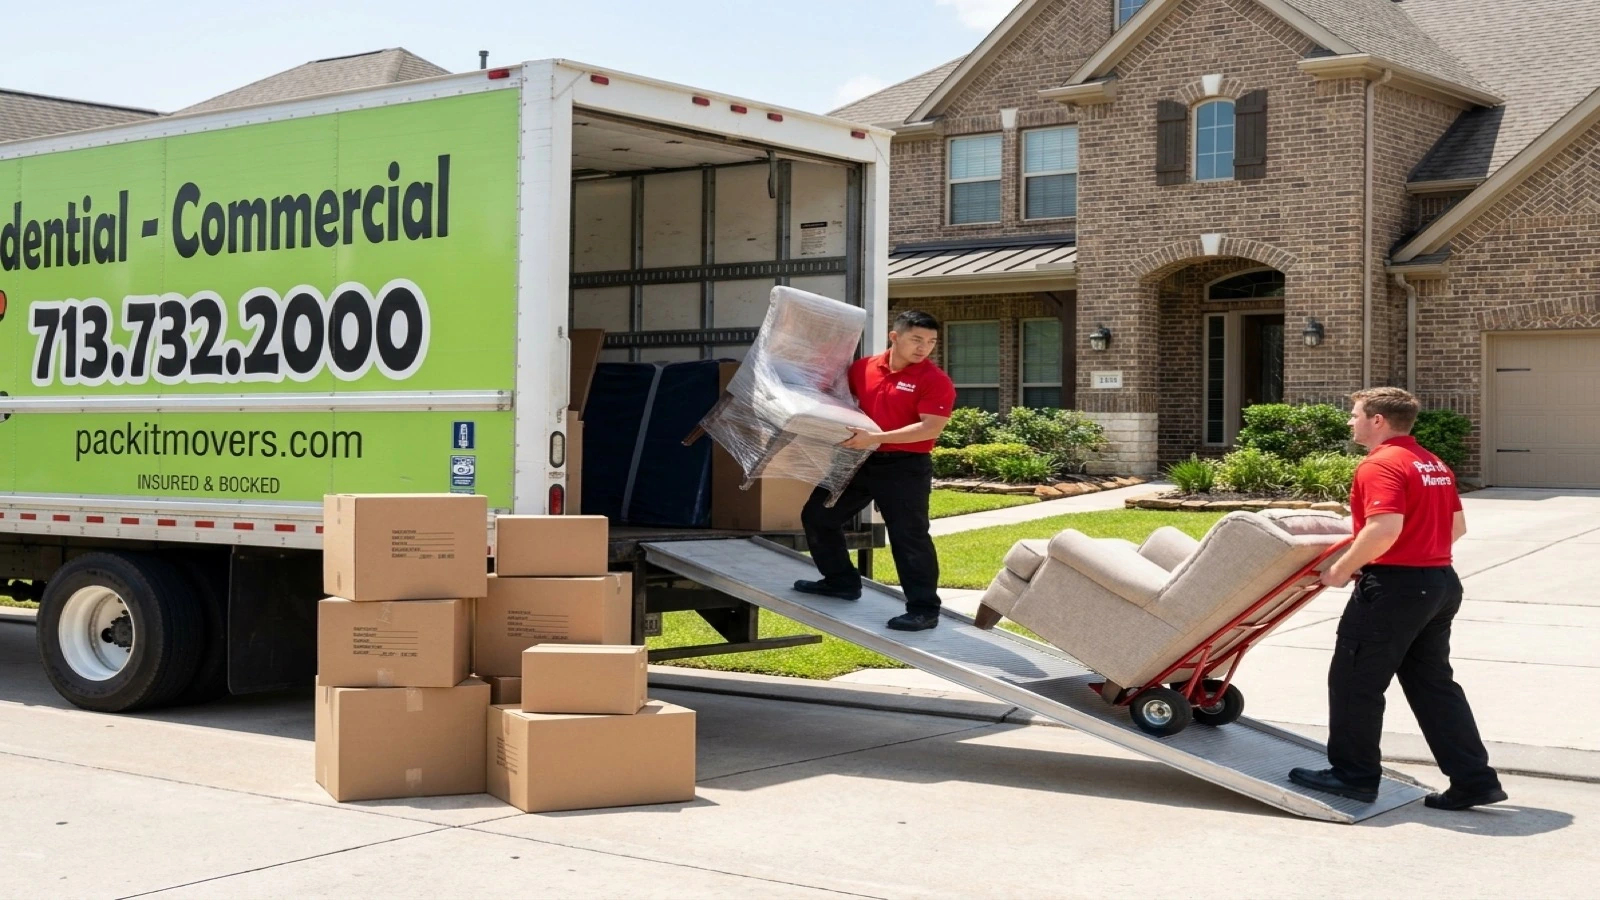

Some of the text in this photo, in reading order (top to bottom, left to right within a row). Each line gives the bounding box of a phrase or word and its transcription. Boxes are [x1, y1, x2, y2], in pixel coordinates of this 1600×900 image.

[172, 154, 451, 258] Commercial
[33, 285, 425, 381] 713.732.2000
[75, 422, 363, 461] packitmovers.com
[137, 474, 280, 494] INSURED & BOCKED
